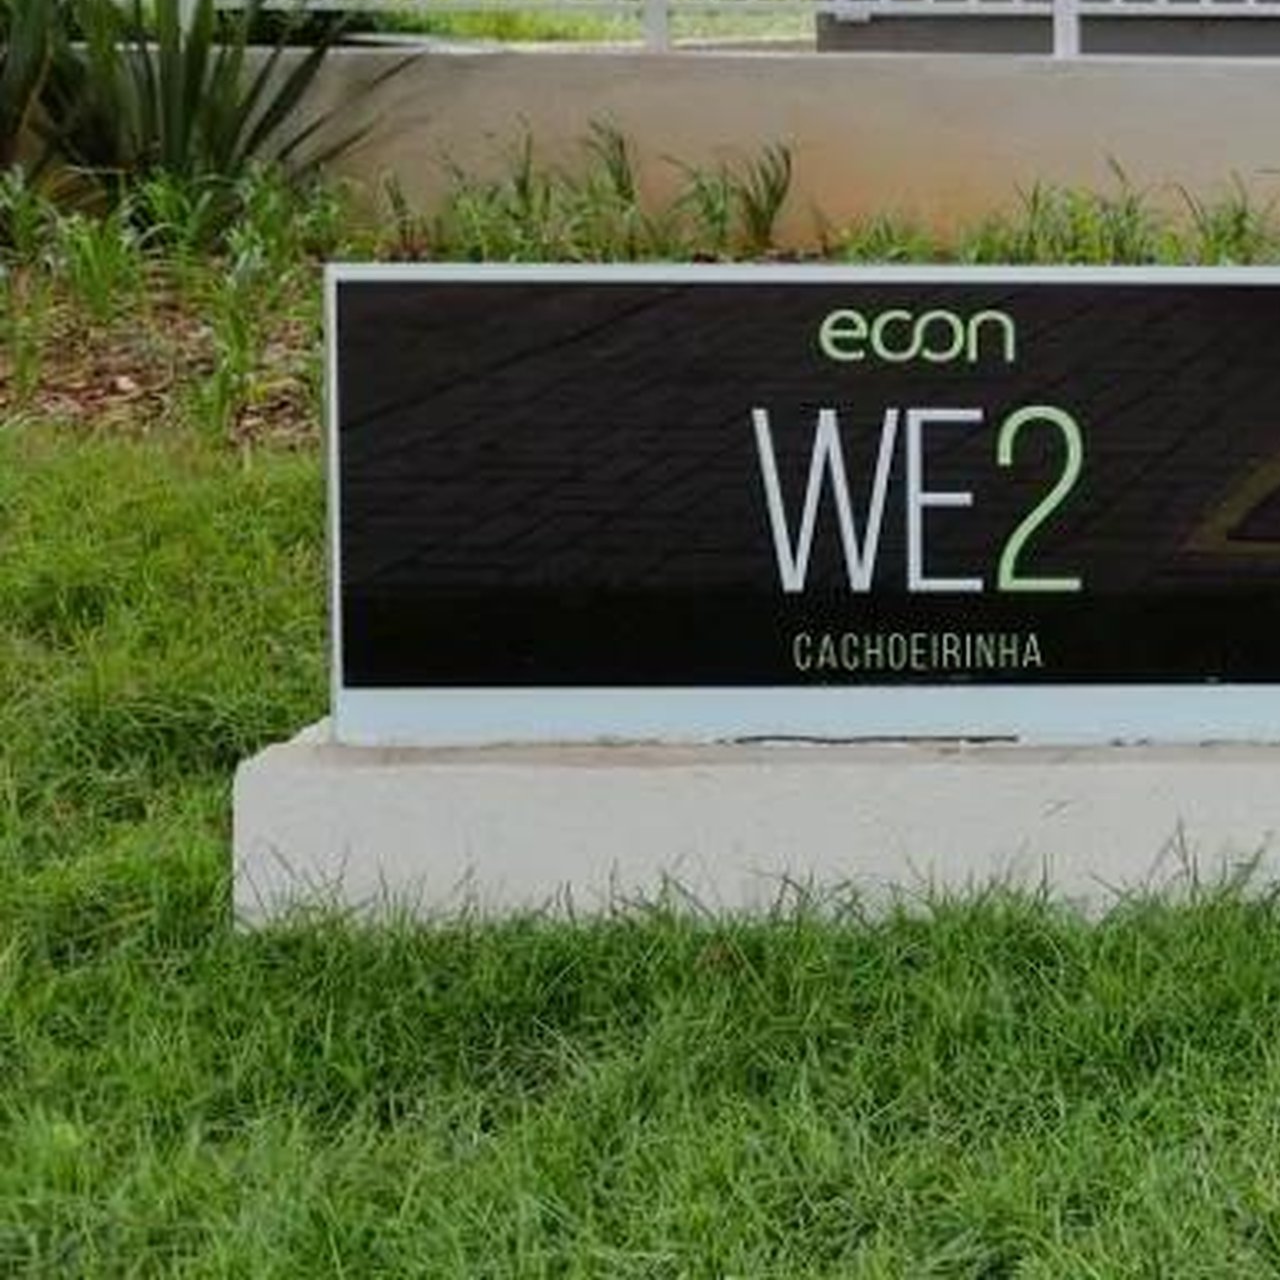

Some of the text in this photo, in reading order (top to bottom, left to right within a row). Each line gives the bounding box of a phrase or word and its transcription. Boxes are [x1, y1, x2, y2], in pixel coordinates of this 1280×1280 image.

[818, 308, 1015, 363] econ
[751, 405, 1083, 593] WE2
[793, 632, 1043, 671] CACHOEIRINHA
